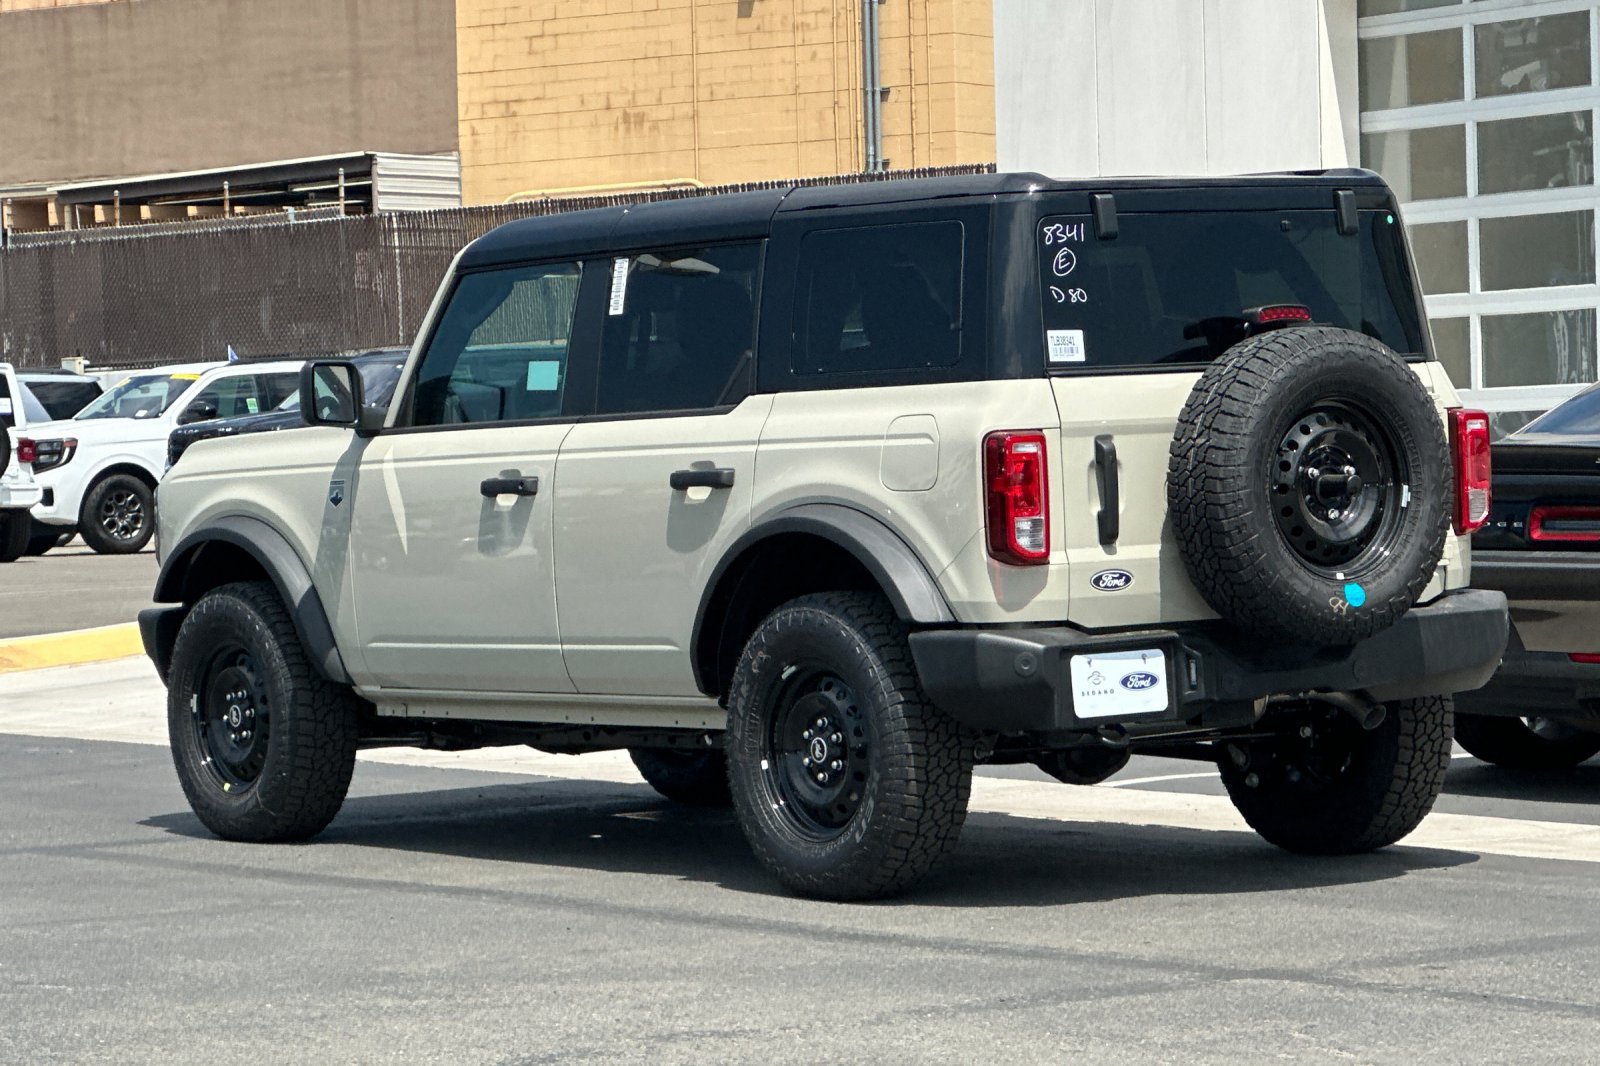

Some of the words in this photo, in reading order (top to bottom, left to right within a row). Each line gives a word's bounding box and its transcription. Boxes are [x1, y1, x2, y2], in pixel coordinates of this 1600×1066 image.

[1043, 222, 1084, 245] 8341
[1099, 573, 1126, 588] Ford
[1127, 674, 1151, 688] Ford
